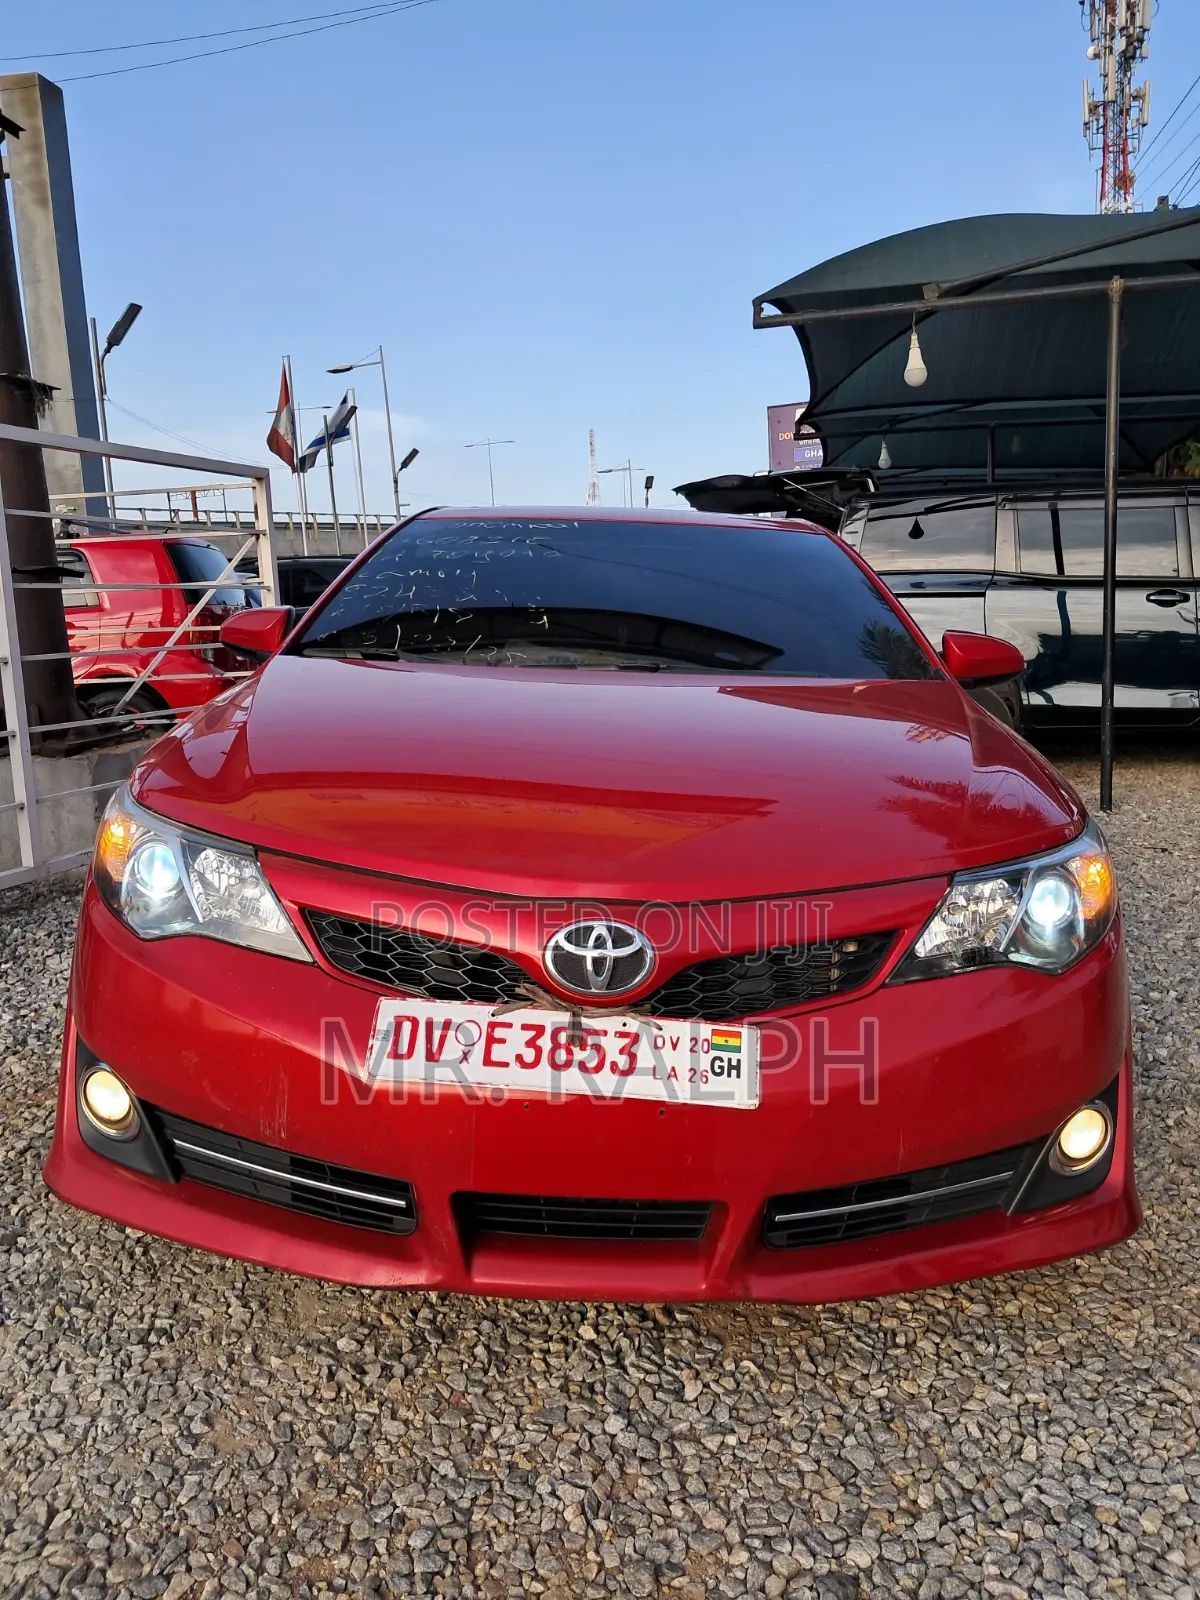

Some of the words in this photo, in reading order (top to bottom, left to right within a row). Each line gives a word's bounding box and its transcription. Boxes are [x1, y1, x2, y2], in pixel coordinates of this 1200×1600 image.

[387, 1015, 453, 1063] DV
[482, 1020, 641, 1077] E3853
[689, 1037, 711, 1055] 20
[687, 1067, 710, 1085] 26
[710, 1055, 742, 1079] GH
